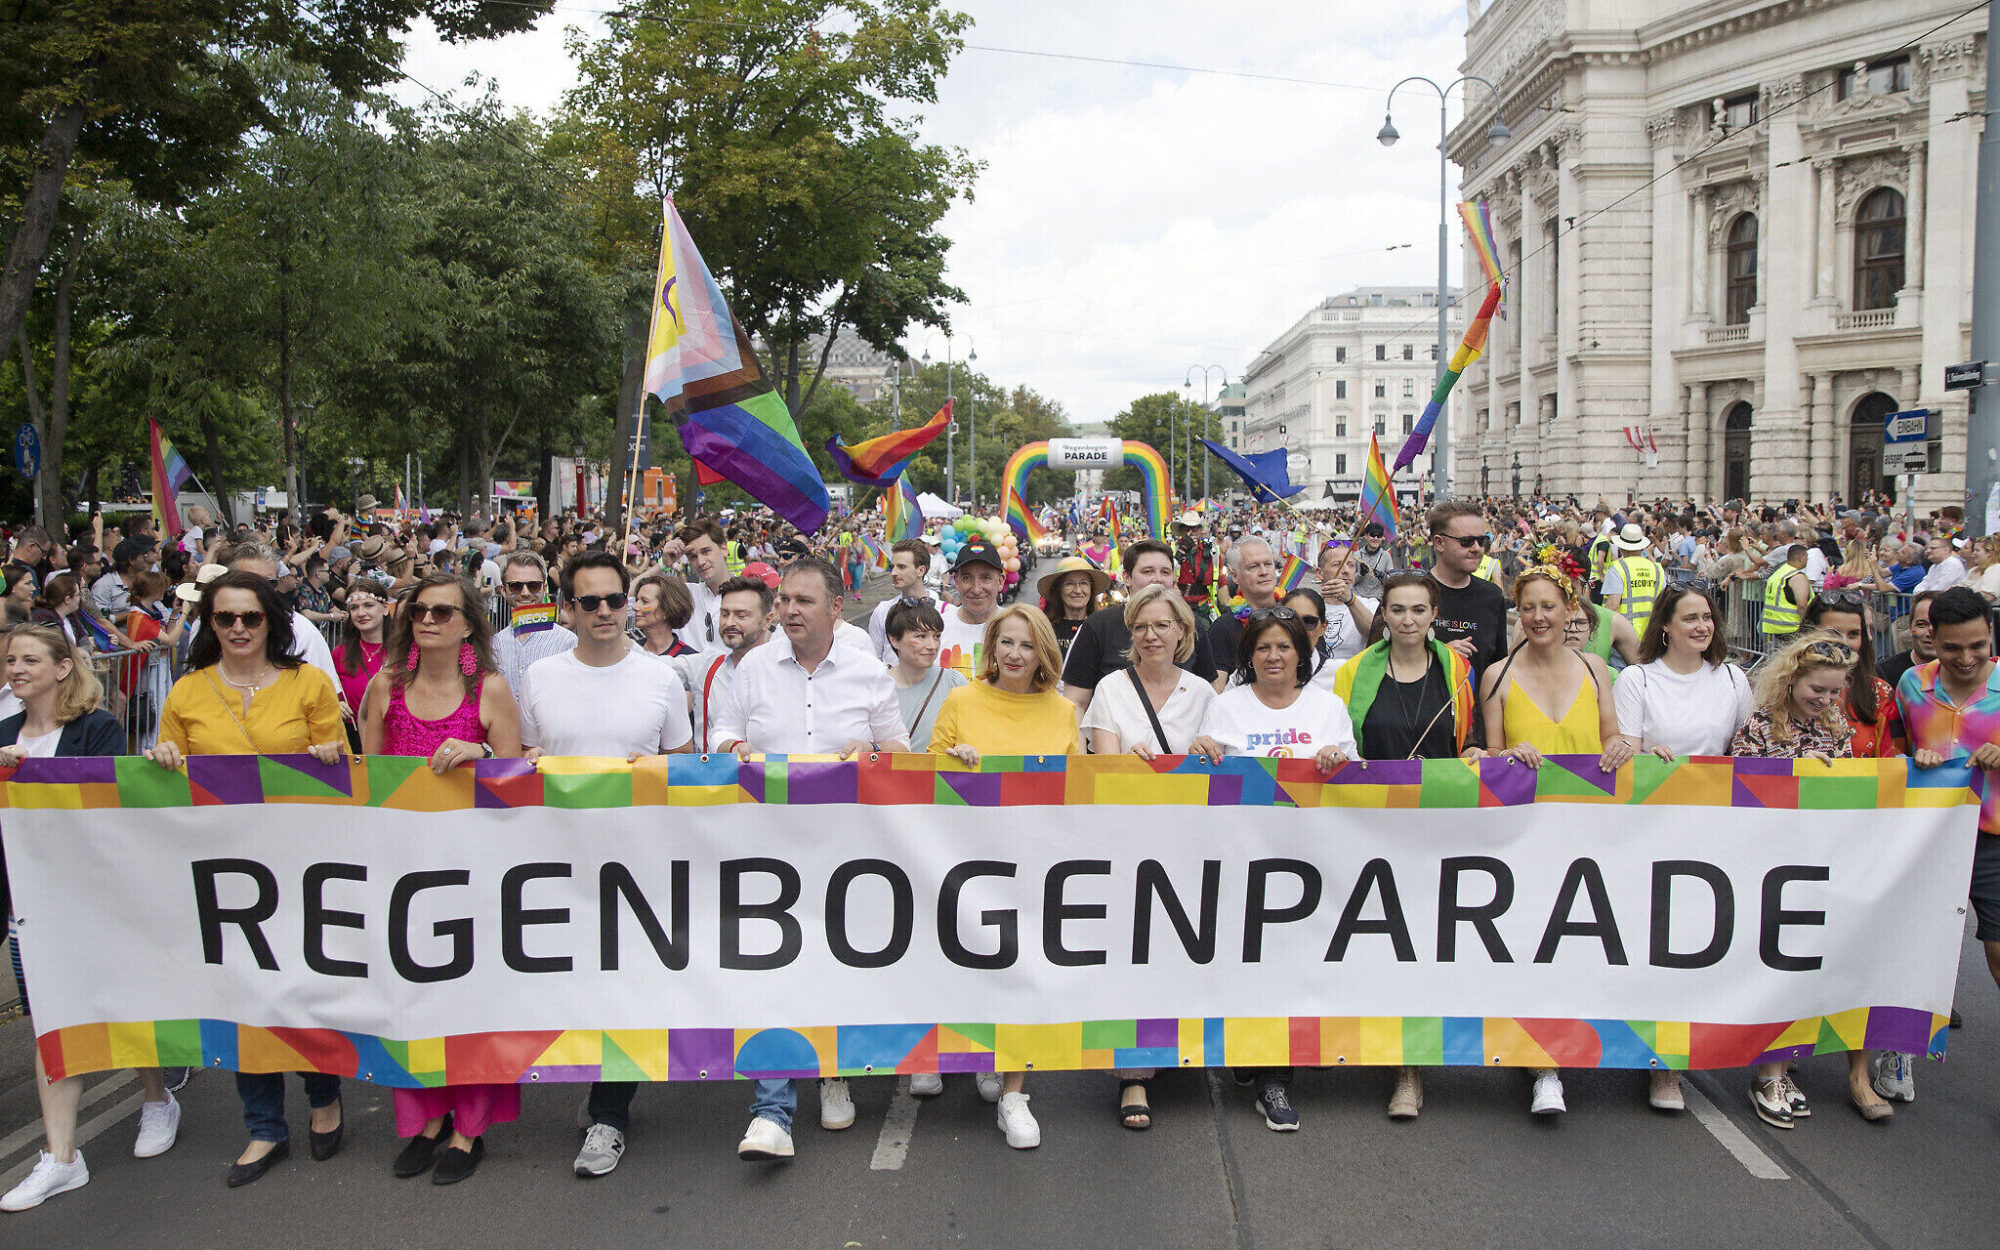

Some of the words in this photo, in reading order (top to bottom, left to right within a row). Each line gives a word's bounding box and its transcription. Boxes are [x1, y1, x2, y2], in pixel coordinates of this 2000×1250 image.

[1897, 419, 1923, 434] EINBAHN
[1064, 452, 1108, 460] PARADE
[1630, 579, 1657, 588] SECURITY
[517, 611, 549, 626] NEOS
[1435, 618, 1450, 628] THIS
[1451, 620, 1459, 629] IS
[1459, 621, 1478, 630] LOVE
[1246, 728, 1313, 751] pride
[190, 855, 1831, 984] REGENBOGENPARADE
